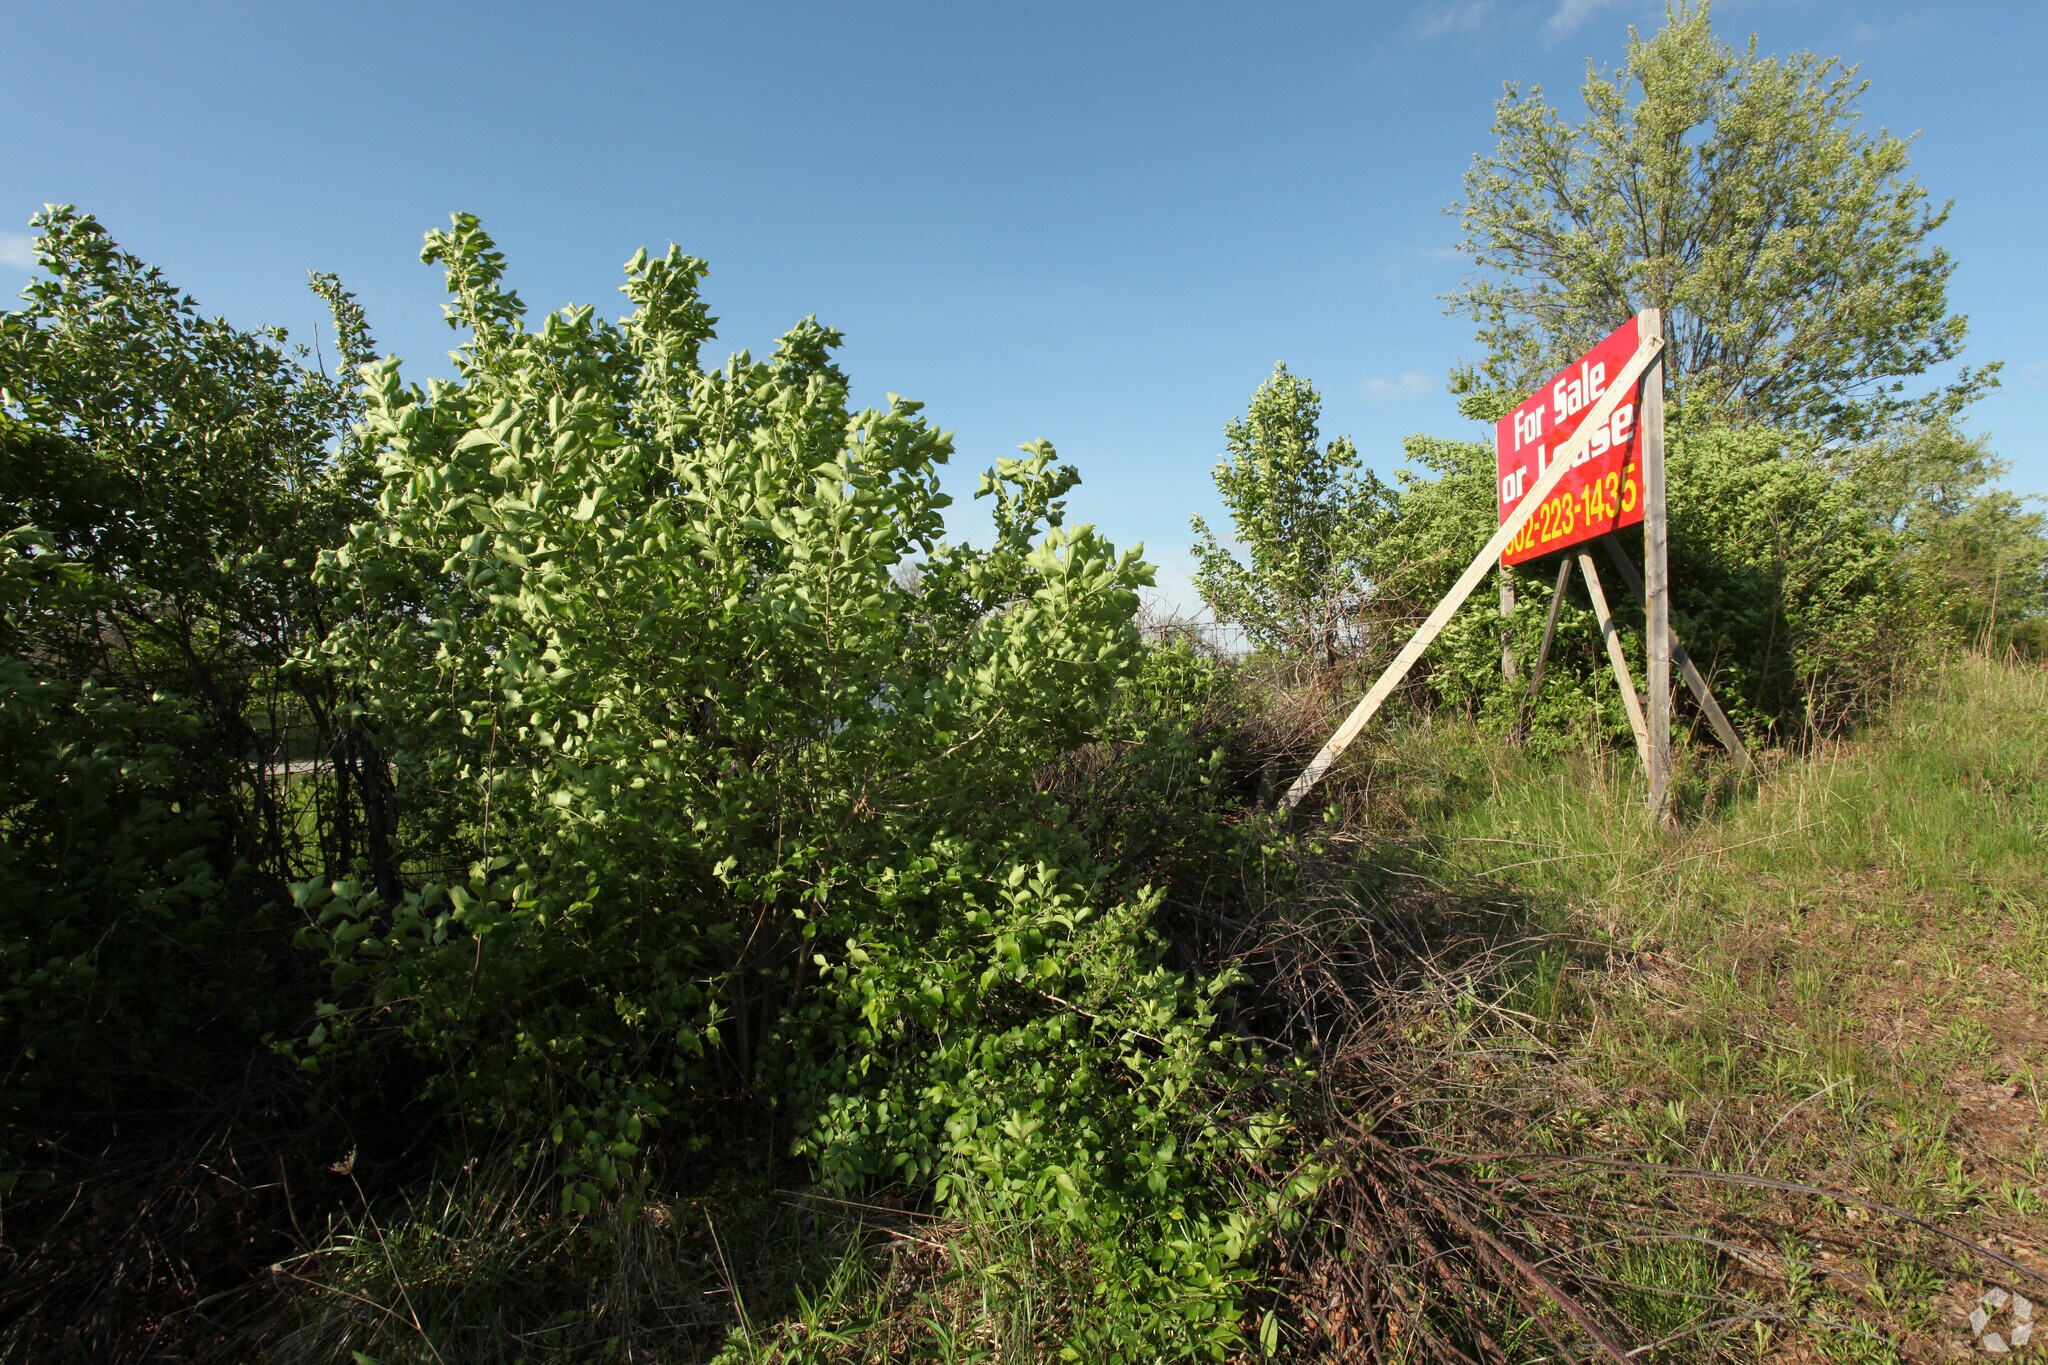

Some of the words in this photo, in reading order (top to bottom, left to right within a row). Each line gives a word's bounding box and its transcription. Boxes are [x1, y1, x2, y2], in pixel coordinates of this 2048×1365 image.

[1502, 465, 1527, 504] or
[1537, 403, 1634, 481] Lse
[1514, 404, 1545, 452] For
[1553, 361, 1605, 426] Sale
